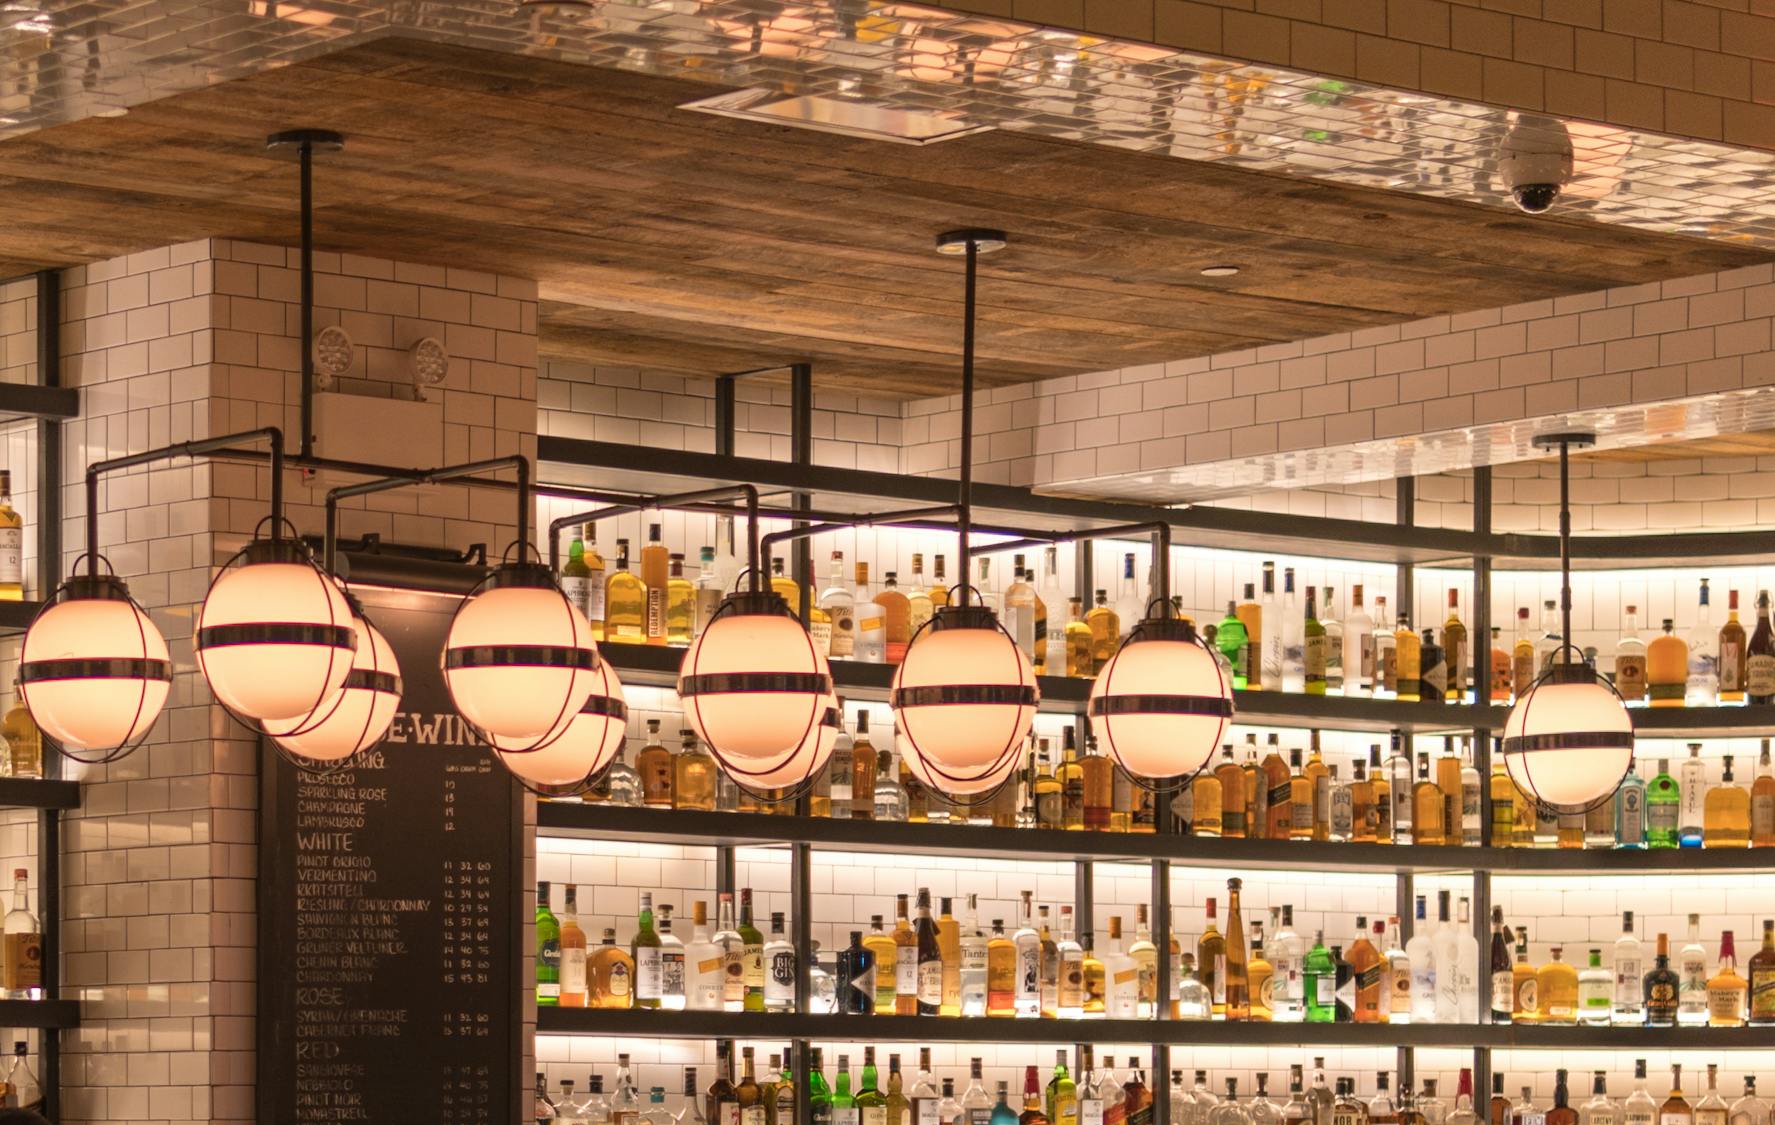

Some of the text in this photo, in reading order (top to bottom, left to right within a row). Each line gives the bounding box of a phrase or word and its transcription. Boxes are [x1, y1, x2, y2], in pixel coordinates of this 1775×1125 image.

[650, 589, 659, 636] REDEMPTION
[297, 772, 355, 785] PROSECCO
[297, 786, 388, 801] SPARKLING ROSE
[297, 800, 366, 815] CHAMPAGNE
[297, 815, 365, 828] LAMBRUSCO
[296, 832, 353, 852] WHITE
[297, 855, 329, 868] PINOT
[333, 855, 372, 869] GRIGIO
[297, 869, 377, 882] VERMENTINO
[961, 948, 986, 959] Tante
[296, 987, 345, 1005] ROSE
[296, 1041, 340, 1061] RED
